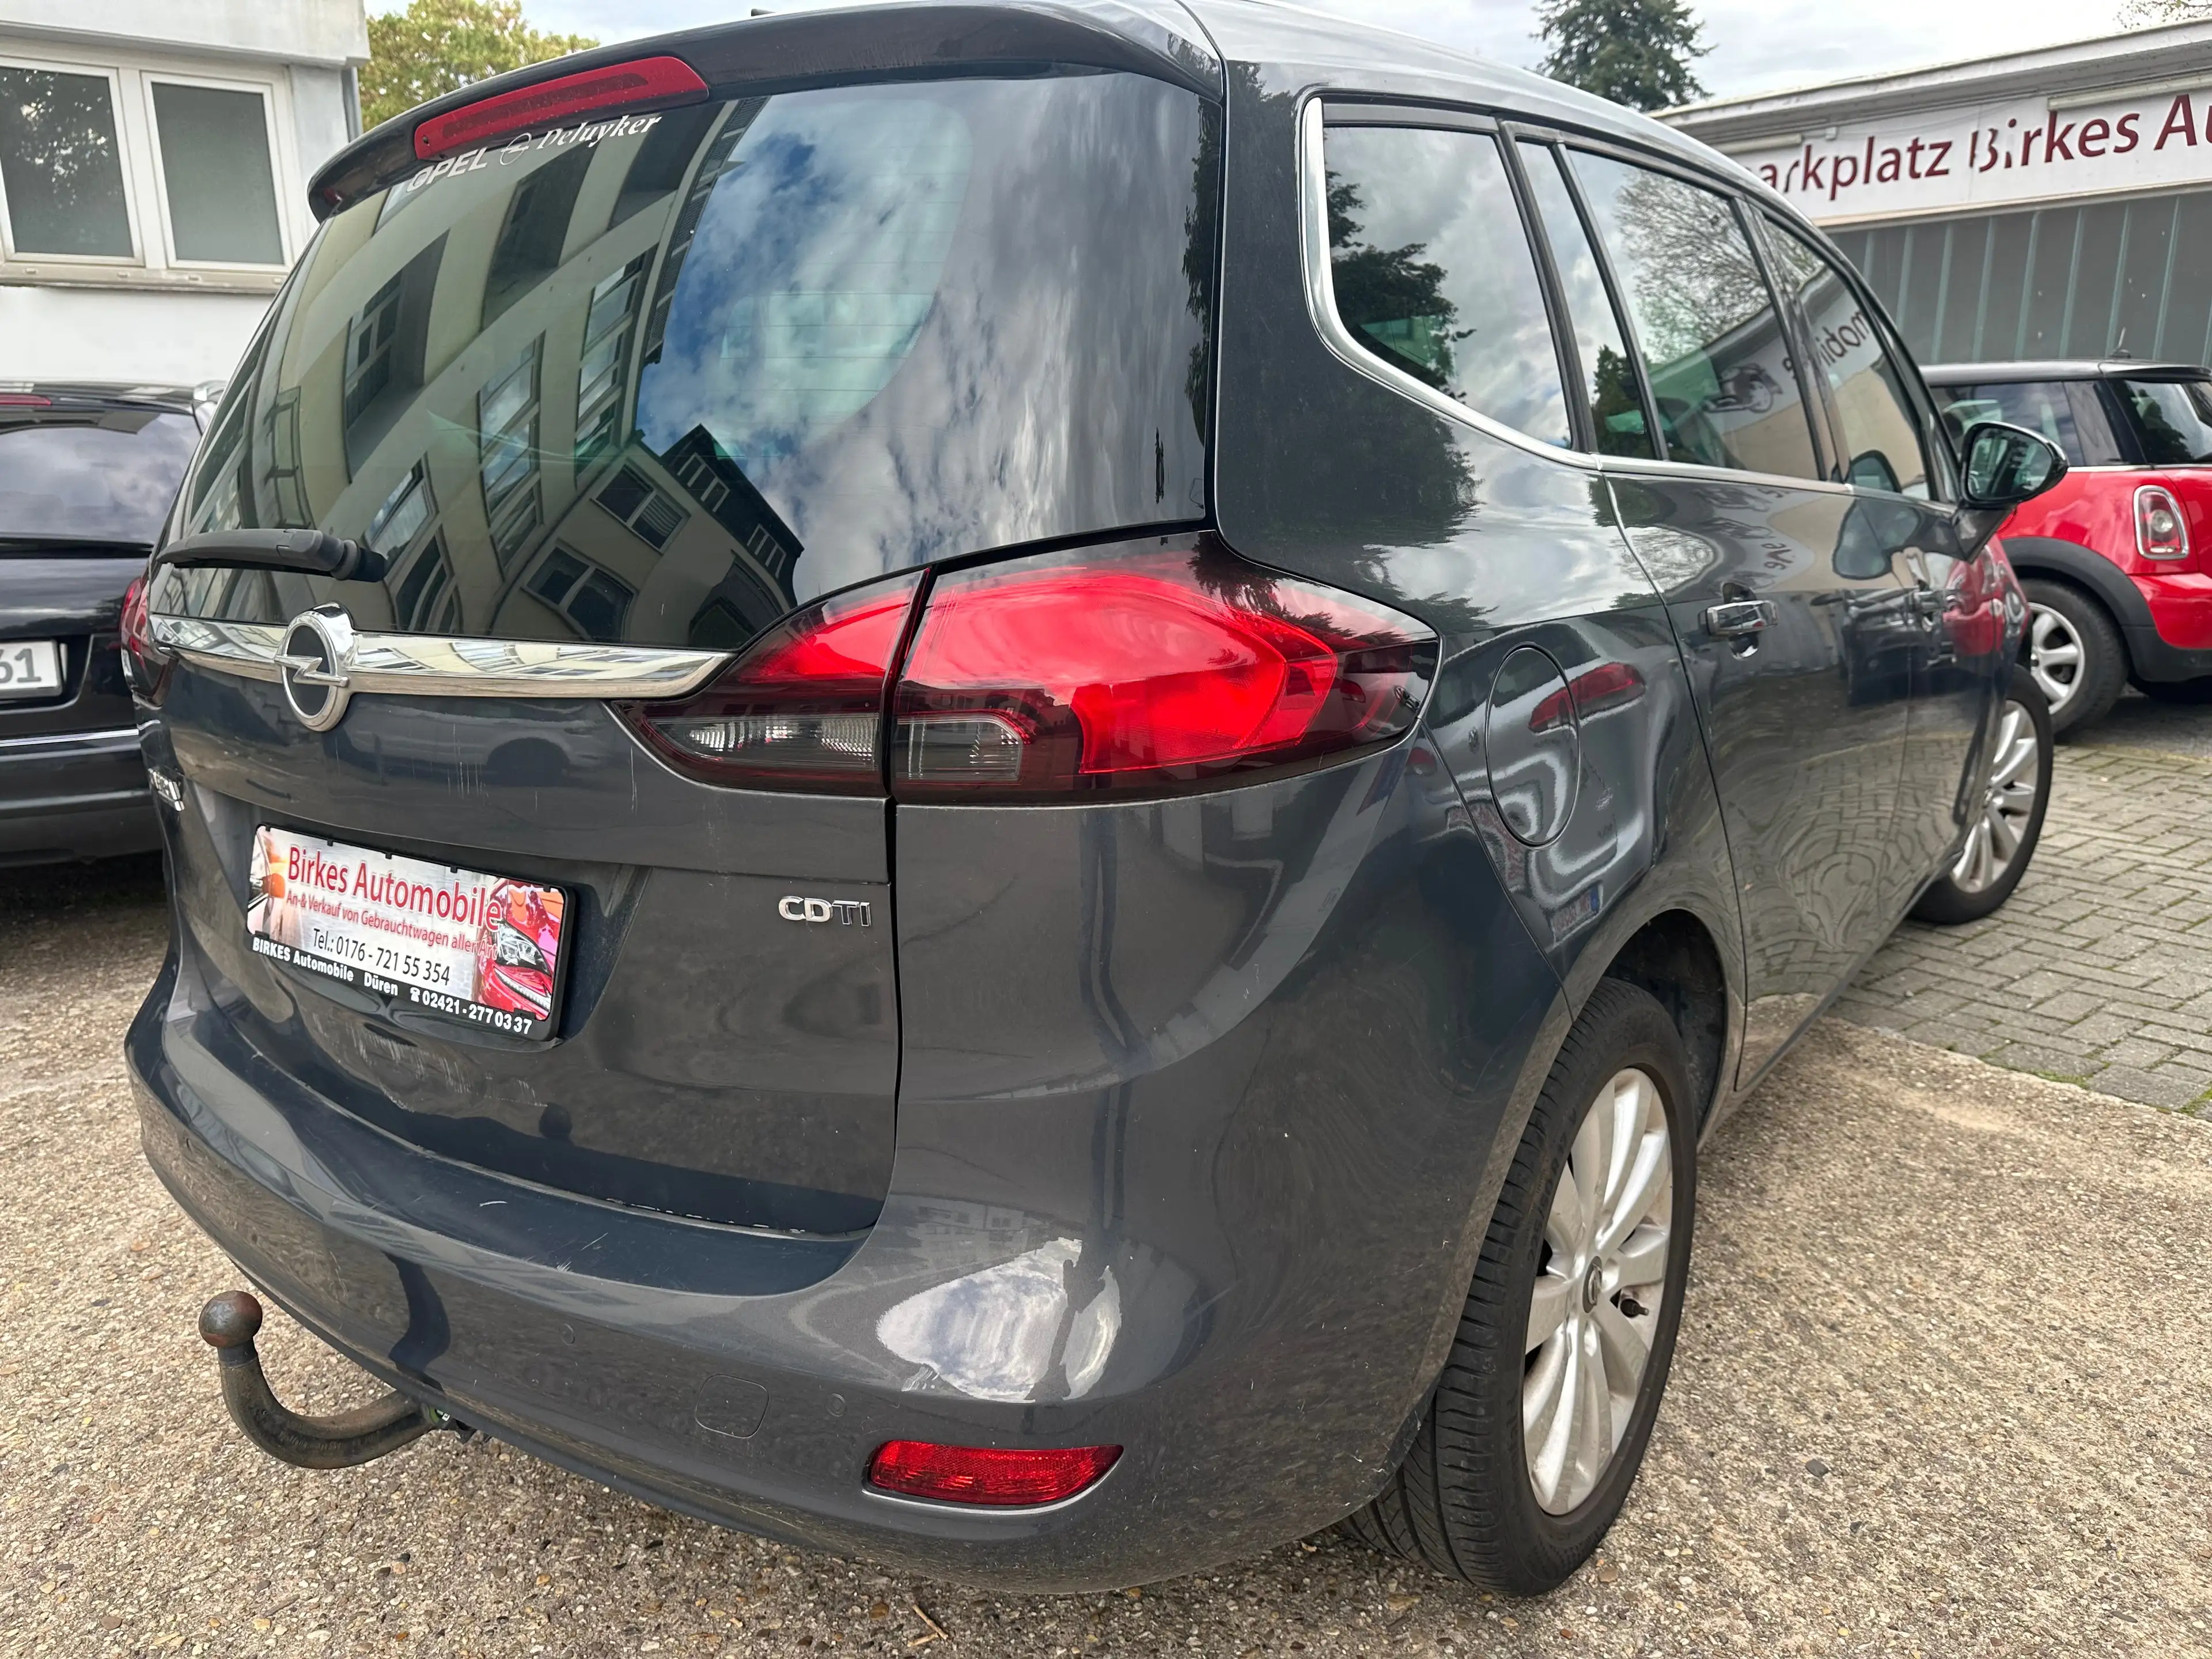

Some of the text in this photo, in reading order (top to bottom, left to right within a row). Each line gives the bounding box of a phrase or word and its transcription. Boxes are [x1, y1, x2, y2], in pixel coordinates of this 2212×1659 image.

[406, 114, 662, 194] OPEL Deluyker
[1747, 135, 1952, 201] arkplatz
[1969, 109, 2139, 172] Birkes
[289, 846, 502, 931] Birkes Automobile
[778, 895, 872, 927] CDTI
[309, 894, 342, 917] Verkauf
[343, 908, 359, 922] von
[361, 910, 449, 947] Gebrauchtwagen
[452, 933, 477, 954] aller
[478, 937, 498, 960] Art
[313, 928, 334, 952] Tel.:
[336, 936, 366, 961] 0176
[376, 947, 399, 972] 721
[403, 955, 421, 977] 55
[423, 960, 450, 986] 354
[252, 937, 291, 961] BIRKES
[293, 950, 354, 982] Automobile
[363, 971, 399, 996] Düren
